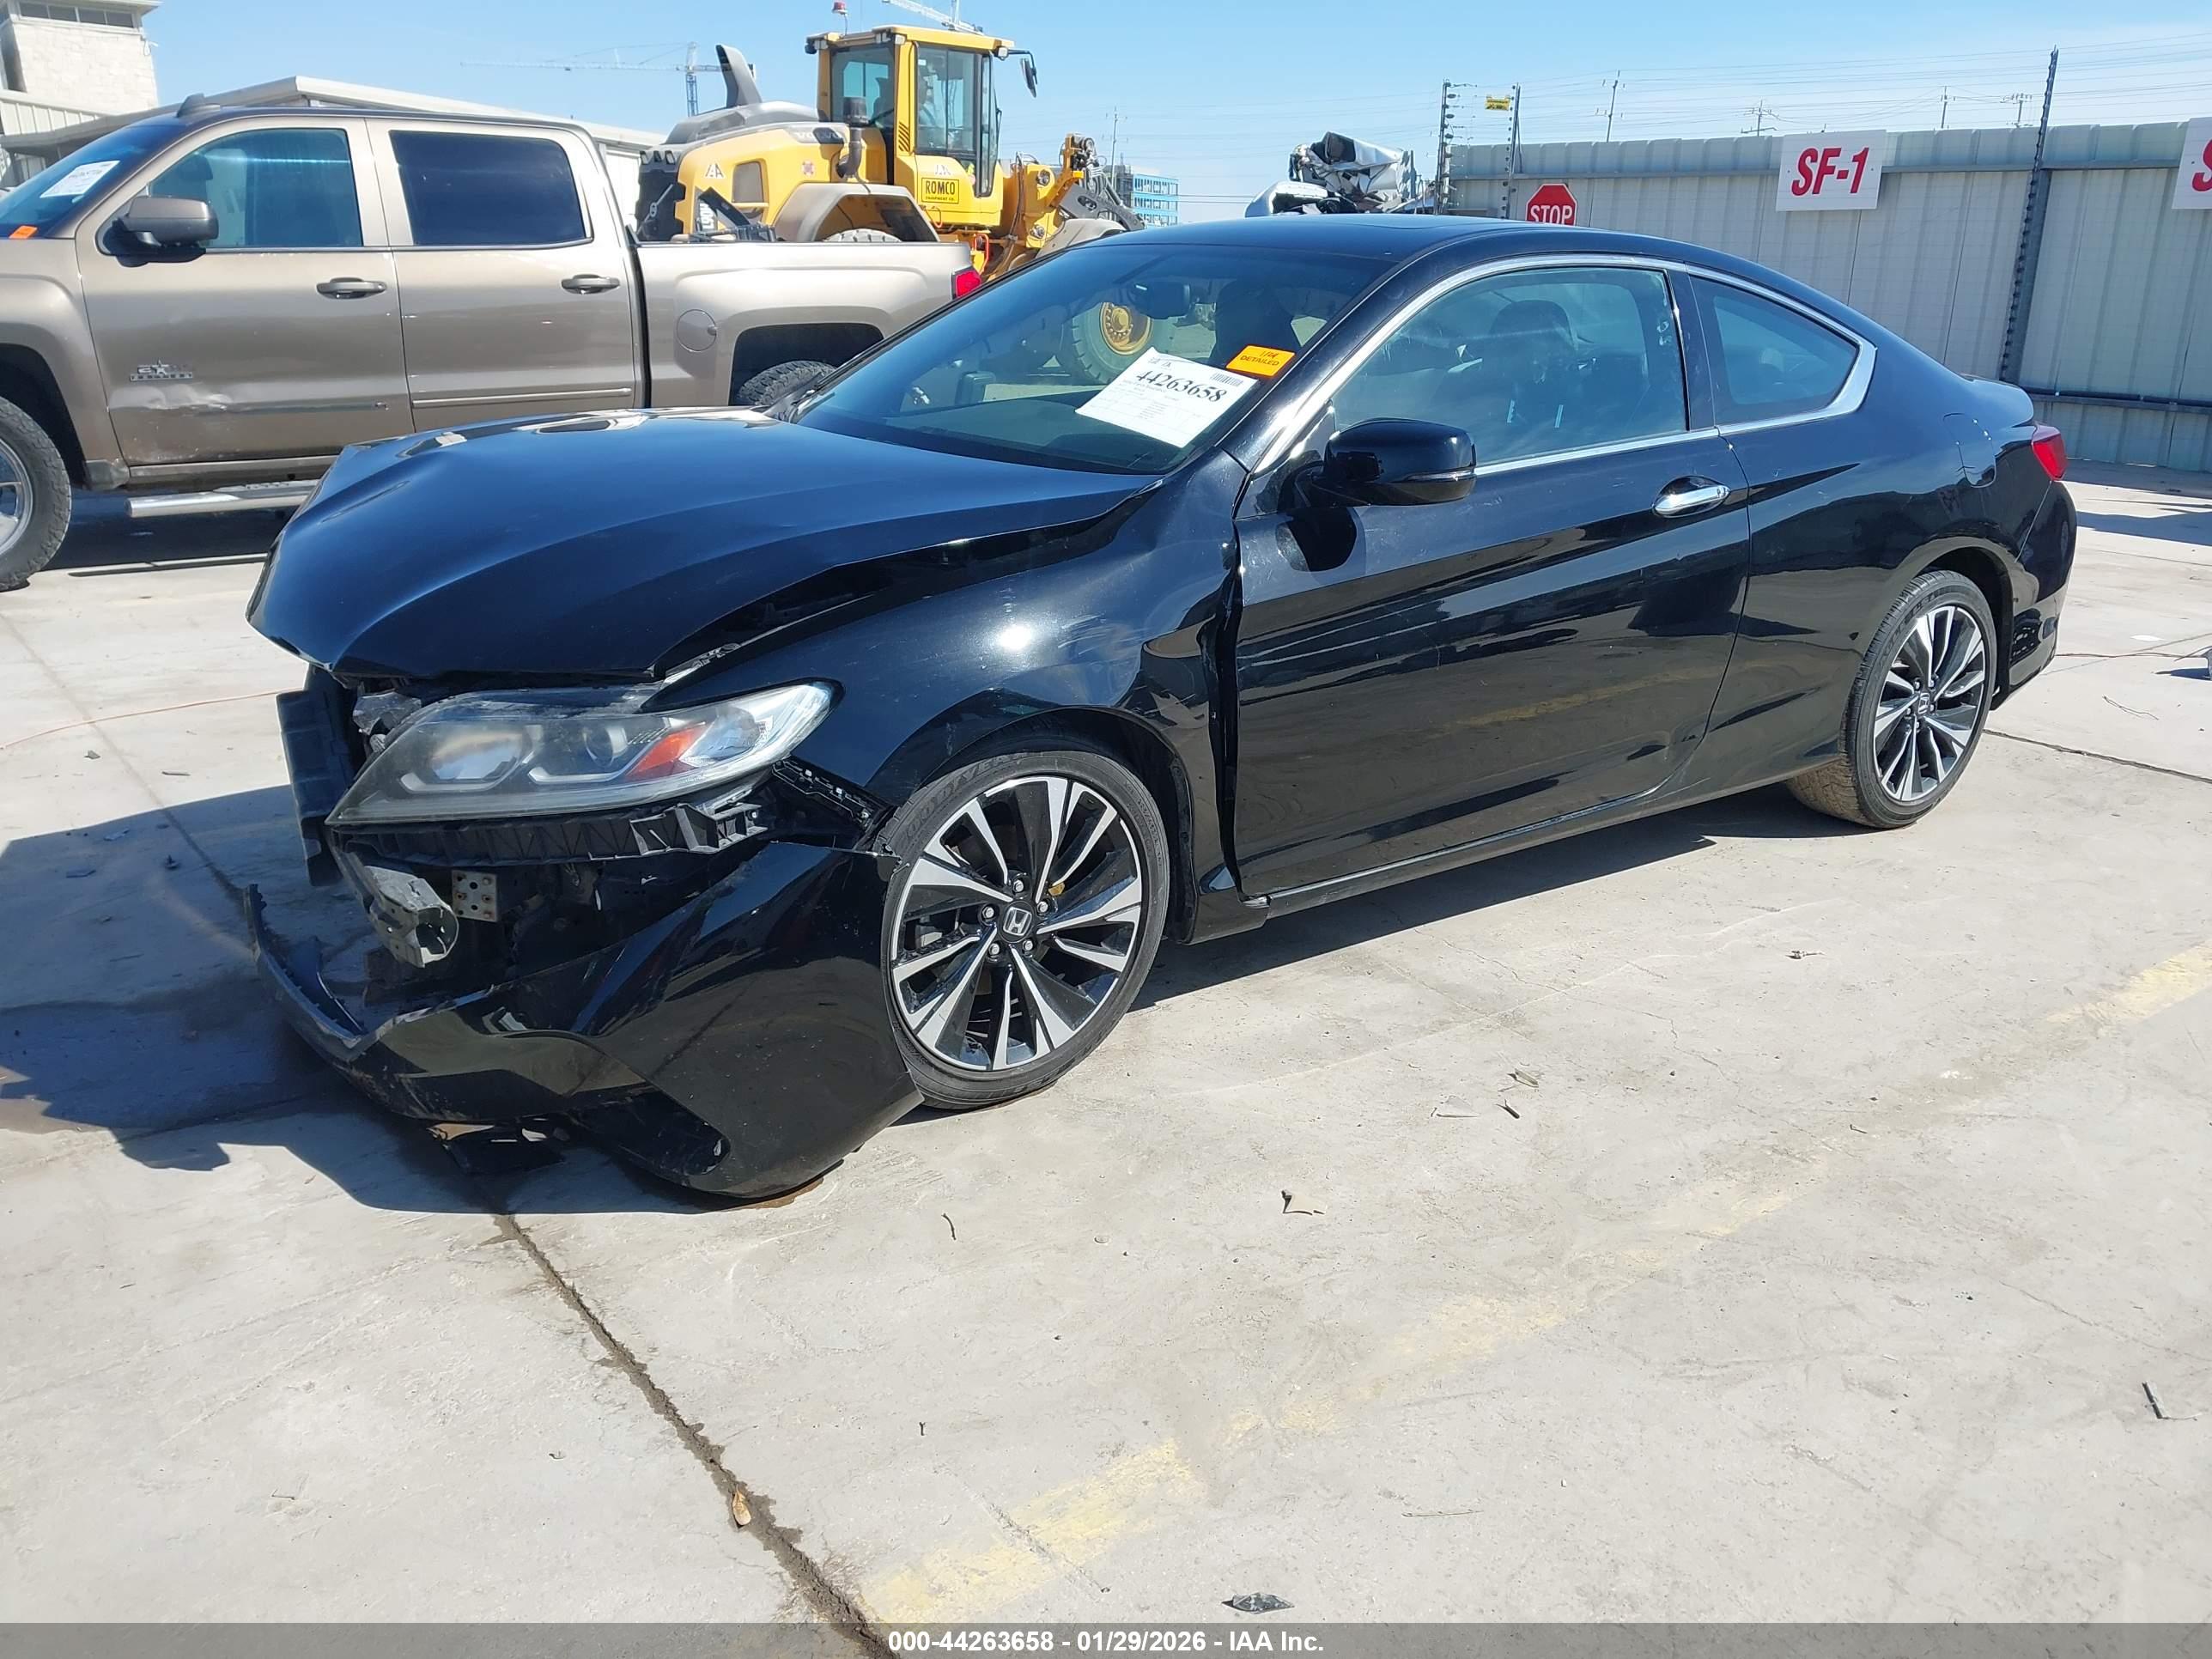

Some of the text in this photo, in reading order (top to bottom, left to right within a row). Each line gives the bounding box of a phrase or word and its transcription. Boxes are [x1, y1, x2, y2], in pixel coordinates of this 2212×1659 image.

[1791, 147, 1869, 196] SF-1
[926, 180, 955, 195] ROMCO
[1530, 205, 1572, 225] STOP
[1240, 355, 1279, 366] DETAILED
[1136, 370, 1227, 403] 44263658
